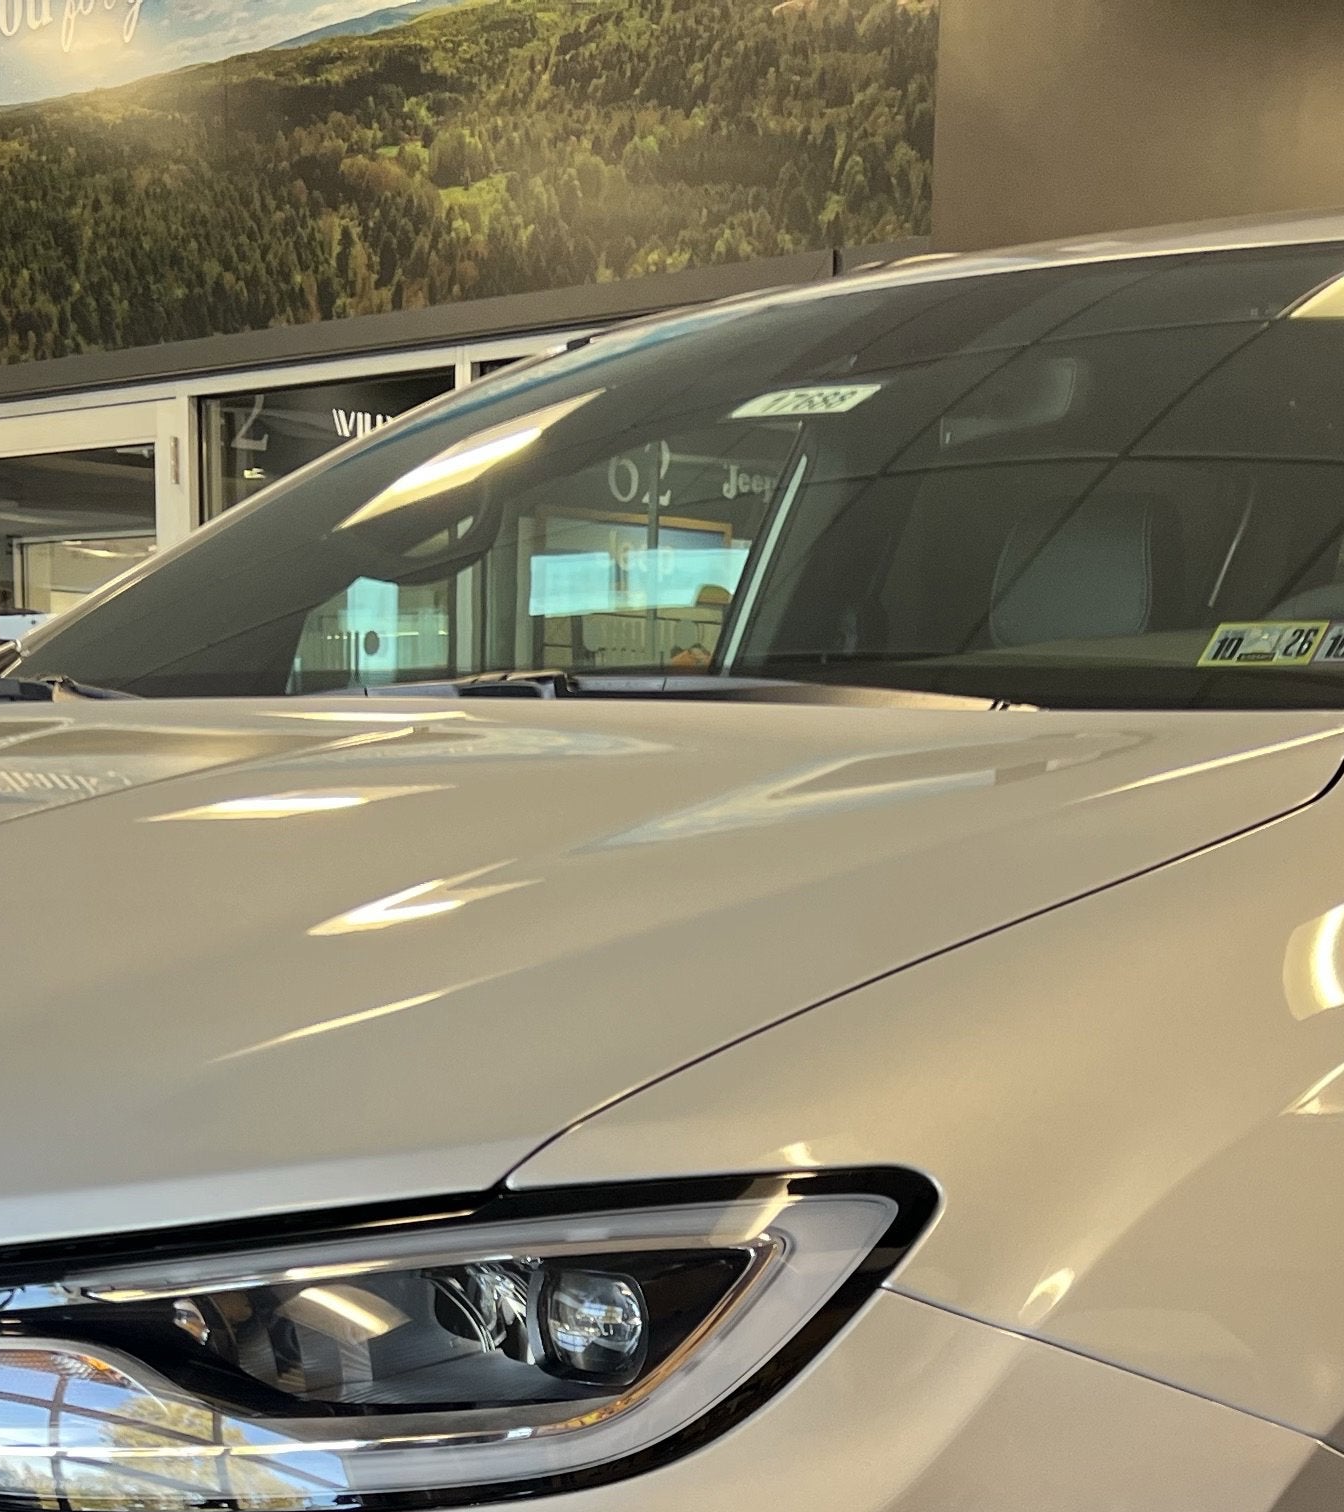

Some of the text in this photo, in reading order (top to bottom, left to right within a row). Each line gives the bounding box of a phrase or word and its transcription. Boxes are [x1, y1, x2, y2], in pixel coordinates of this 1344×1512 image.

[722, 463, 775, 504] Jeep
[1212, 628, 1320, 661] 10 26
